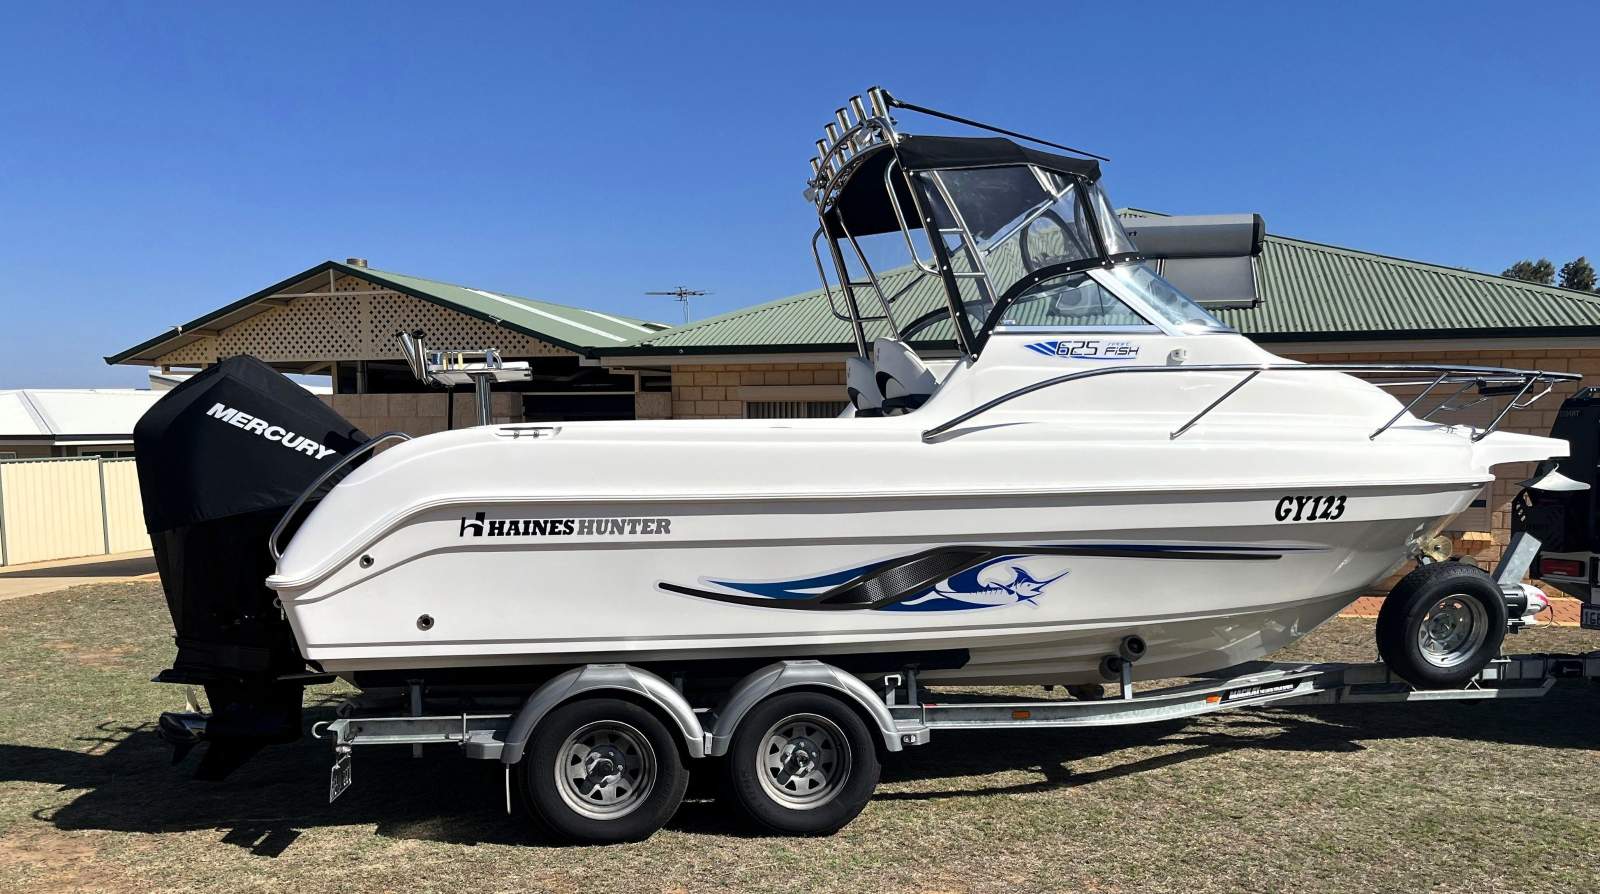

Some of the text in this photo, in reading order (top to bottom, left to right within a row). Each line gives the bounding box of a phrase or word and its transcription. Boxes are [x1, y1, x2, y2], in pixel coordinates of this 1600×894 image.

[1056, 341, 1099, 355] 625
[206, 402, 336, 460] MERCURY
[1275, 495, 1347, 522] GY123
[487, 519, 575, 537] HAINES
[577, 518, 671, 535] HUNTER
